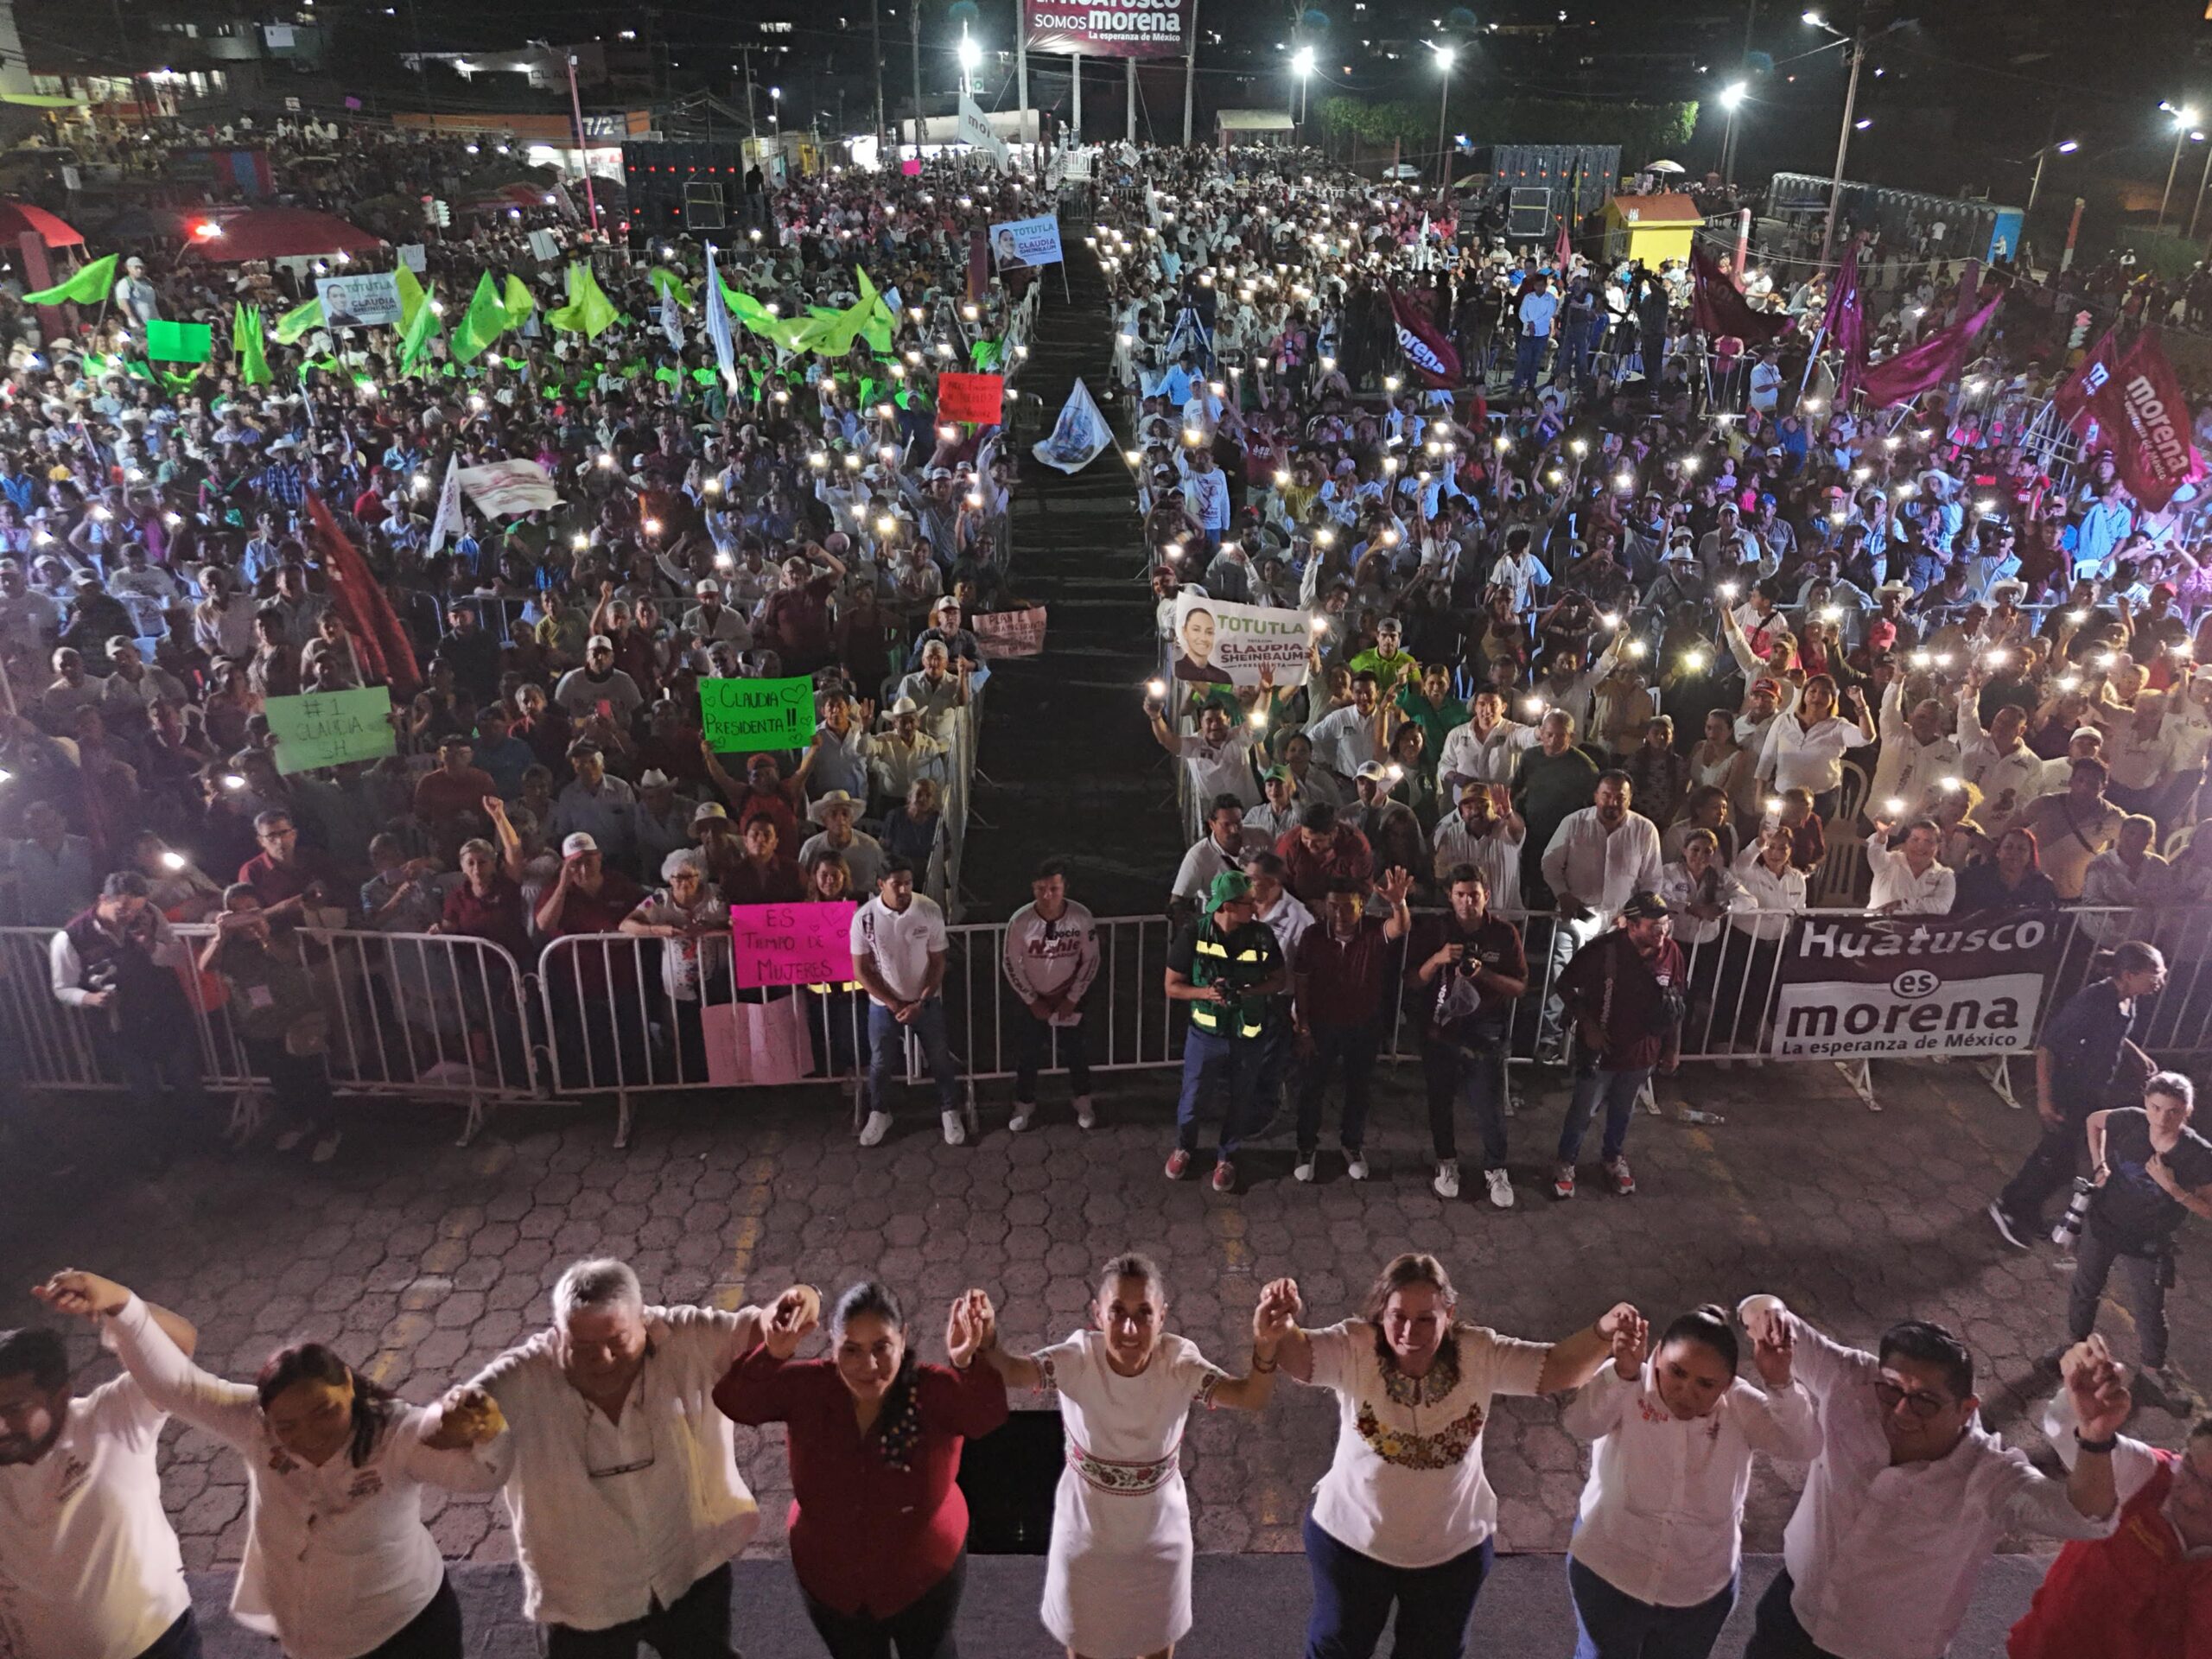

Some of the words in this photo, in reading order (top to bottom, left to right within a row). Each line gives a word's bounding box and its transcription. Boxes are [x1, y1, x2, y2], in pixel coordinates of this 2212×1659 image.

[1034, 14, 1087, 30] SOMOS
[1088, 10, 1180, 32] morena
[1089, 31, 1096, 40] La
[1099, 31, 1139, 42] esperanza
[1141, 33, 1151, 41] de
[1153, 33, 1180, 42] México
[2126, 375, 2189, 474] morena
[1217, 614, 1306, 635] TOTUTLA
[1221, 643, 1303, 654] CLAUDIA
[1221, 652, 1304, 664] SHEINBAUM
[721, 683, 779, 709] CLAUDIA
[766, 908, 795, 928] ES
[1028, 938, 1080, 955] Nhle
[1799, 920, 2045, 958] Huatusco
[757, 959, 833, 982] MUJERES
[1900, 974, 1932, 993] es
[1785, 996, 2019, 1038] morena
[1782, 1041, 1803, 1056] La
[1809, 1036, 1909, 1057] esperanza
[1915, 1034, 1939, 1050] de
[1944, 1033, 2017, 1048] México
